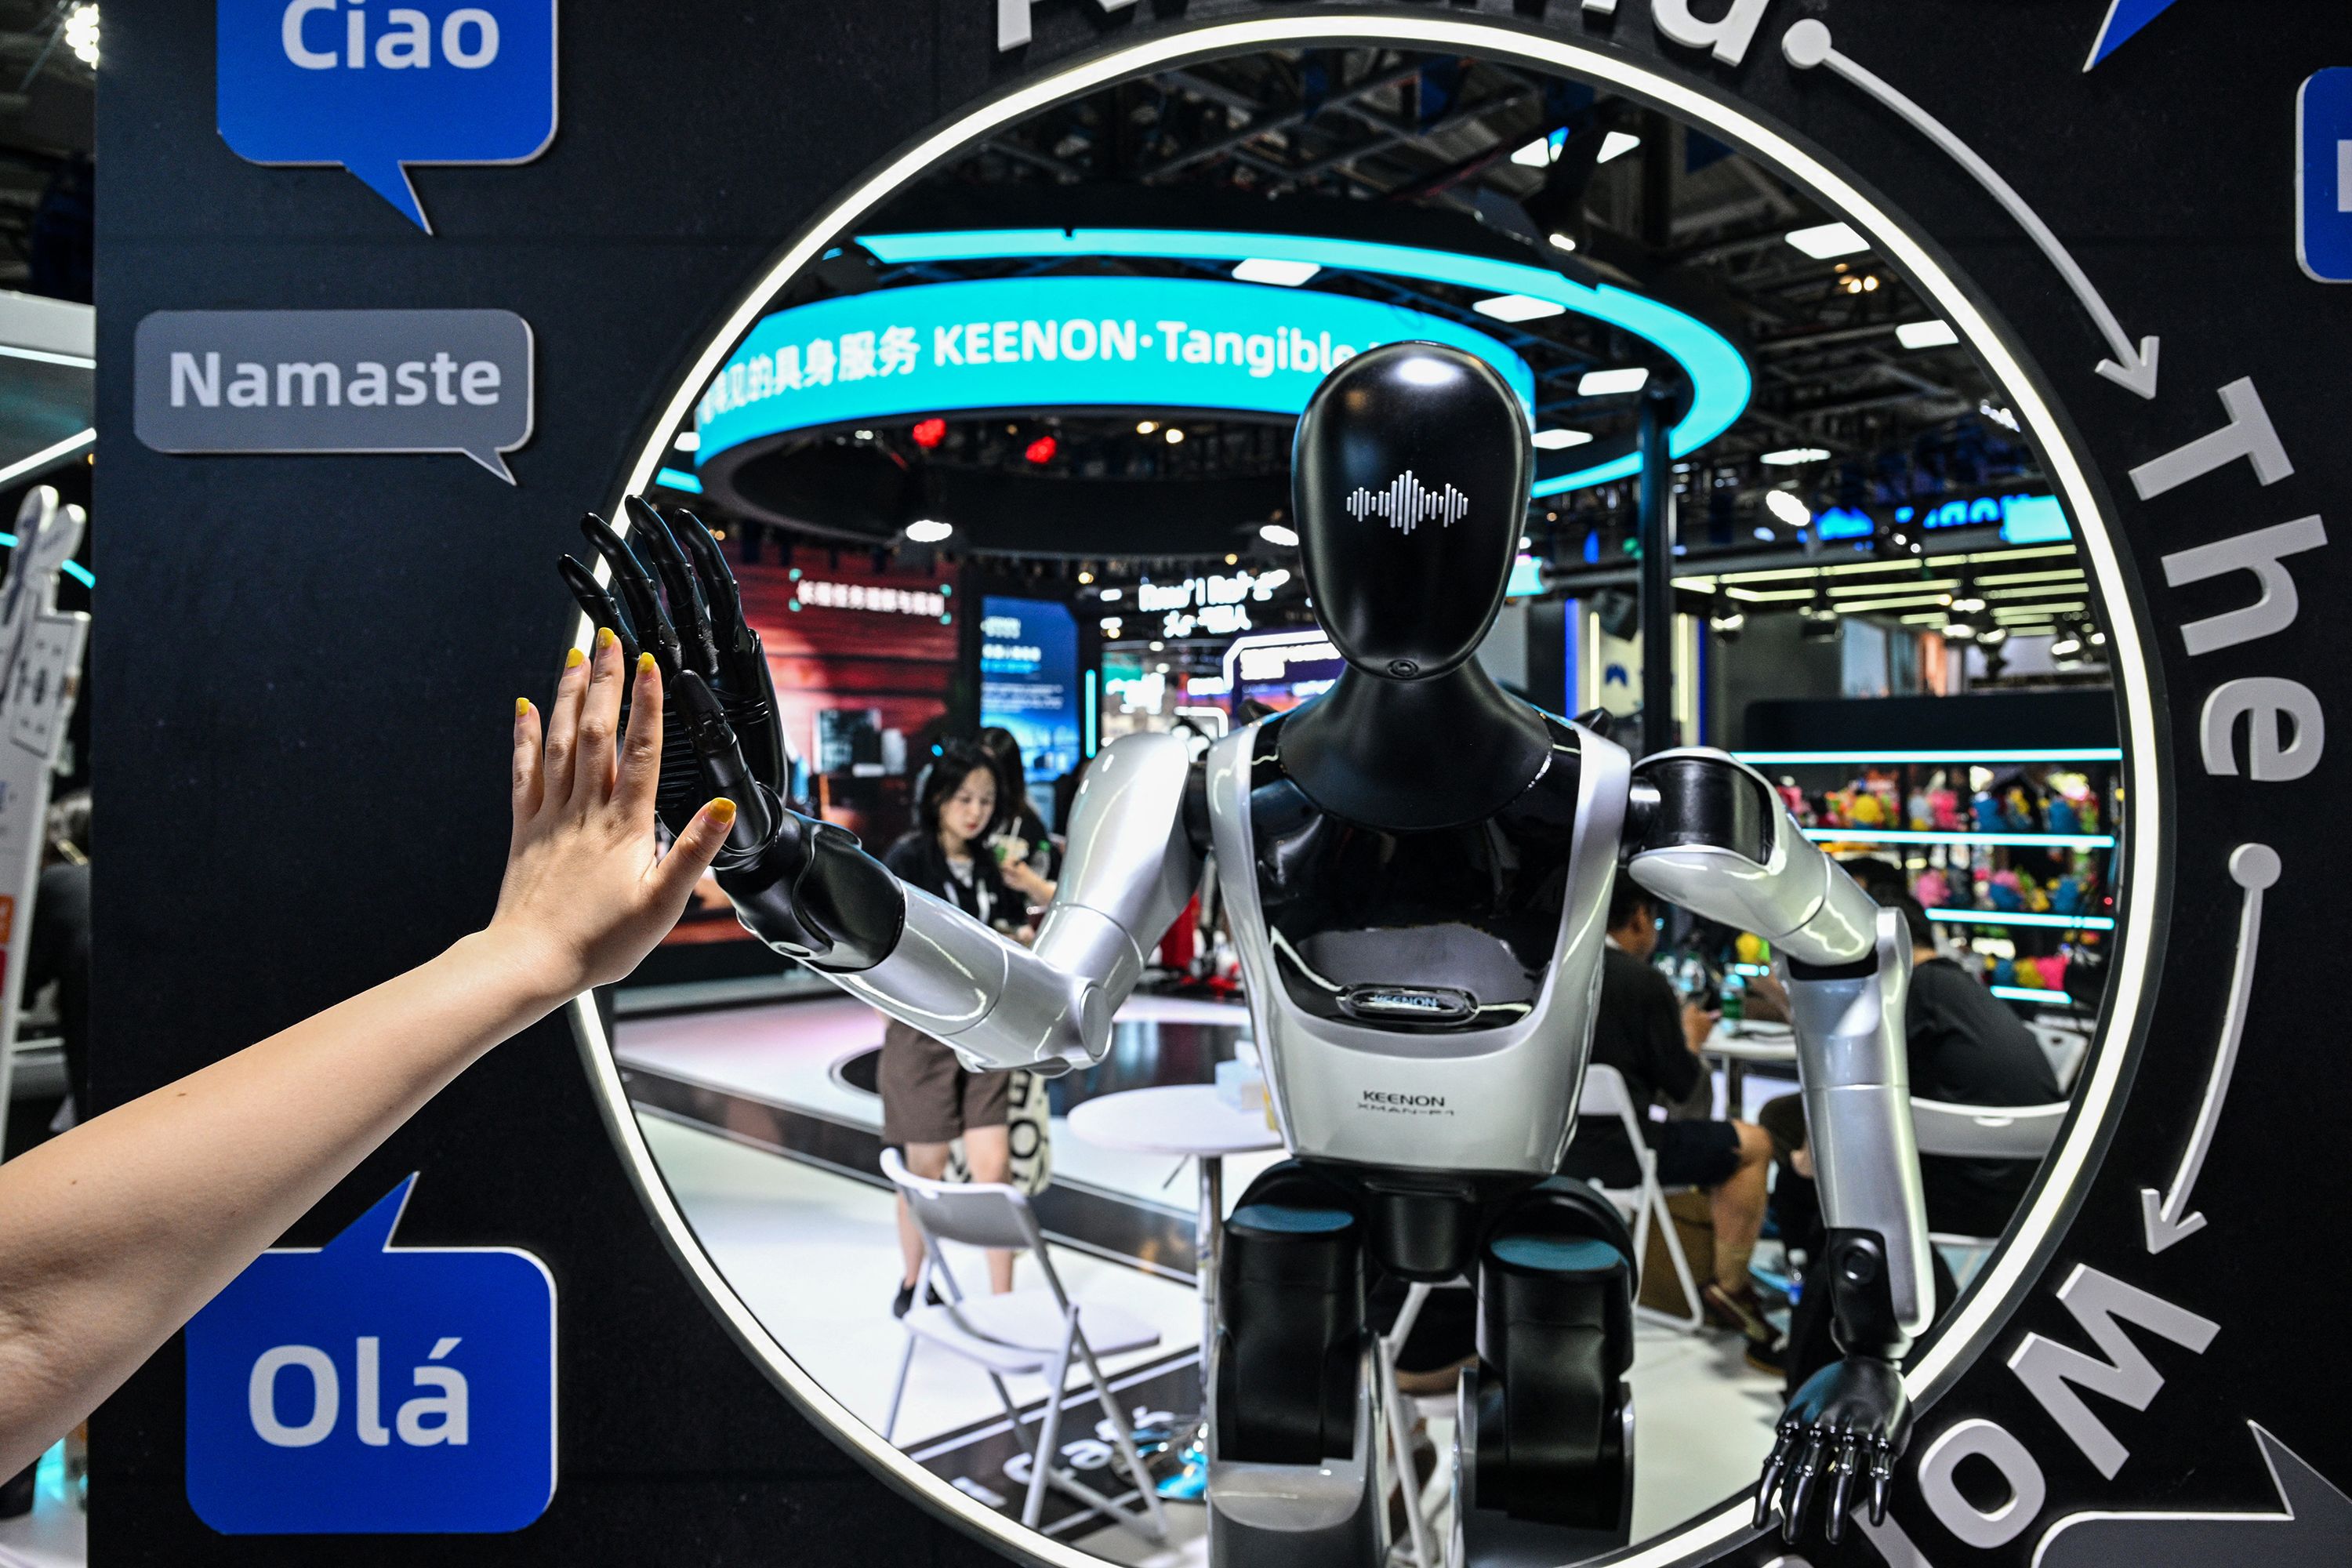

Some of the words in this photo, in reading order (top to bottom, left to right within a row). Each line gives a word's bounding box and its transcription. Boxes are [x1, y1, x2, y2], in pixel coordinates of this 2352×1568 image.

[281, 0, 500, 70] Ciao
[169, 350, 502, 408] Namaste
[2128, 376, 2328, 782] The
[1363, 1090, 1446, 1107] KEENON
[248, 1335, 470, 1448] Olá
